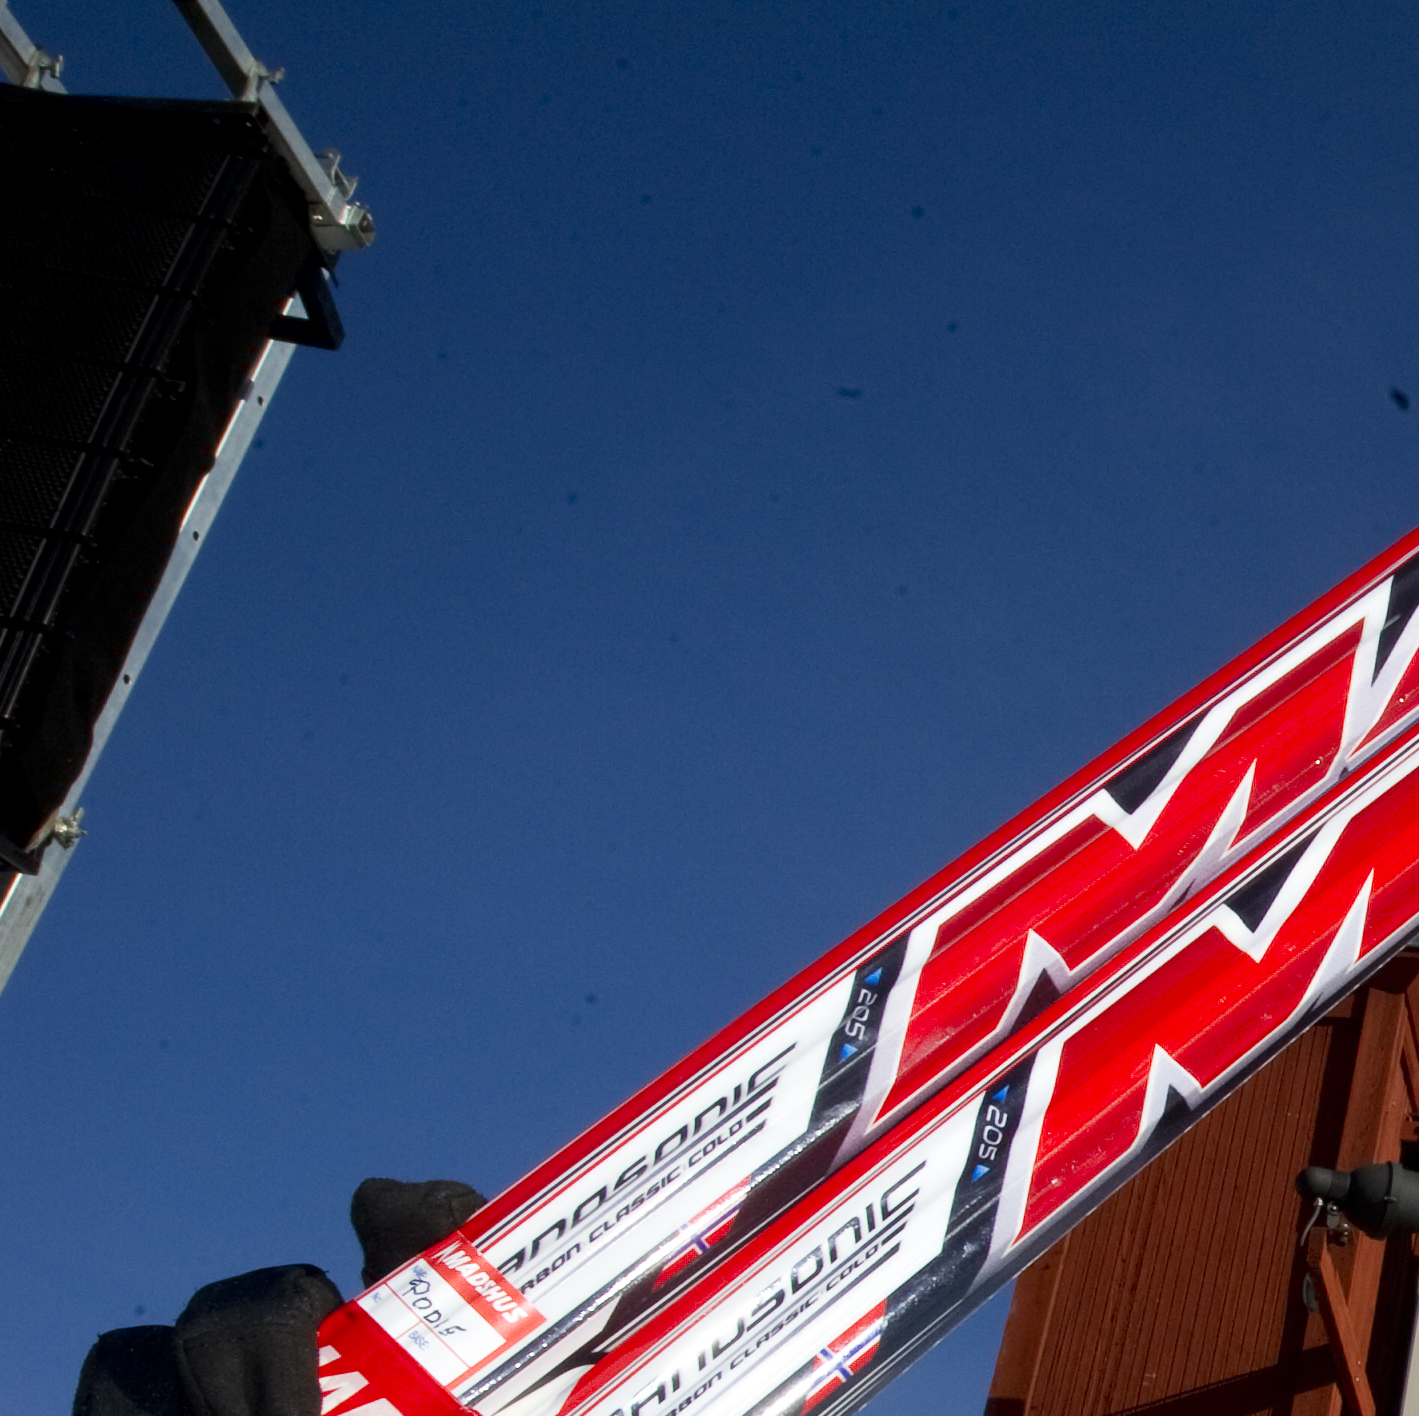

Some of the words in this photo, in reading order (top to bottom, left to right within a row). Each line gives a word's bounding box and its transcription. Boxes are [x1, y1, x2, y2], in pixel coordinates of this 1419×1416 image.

[845, 990, 878, 1039] 205
[977, 1104, 1008, 1162] 205
[589, 1165, 681, 1244] CLASSIC
[688, 1118, 744, 1168] COLD
[443, 1250, 529, 1324] MADSHUS
[729, 1296, 820, 1372] CLASSIC
[825, 1245, 877, 1293] COLD
